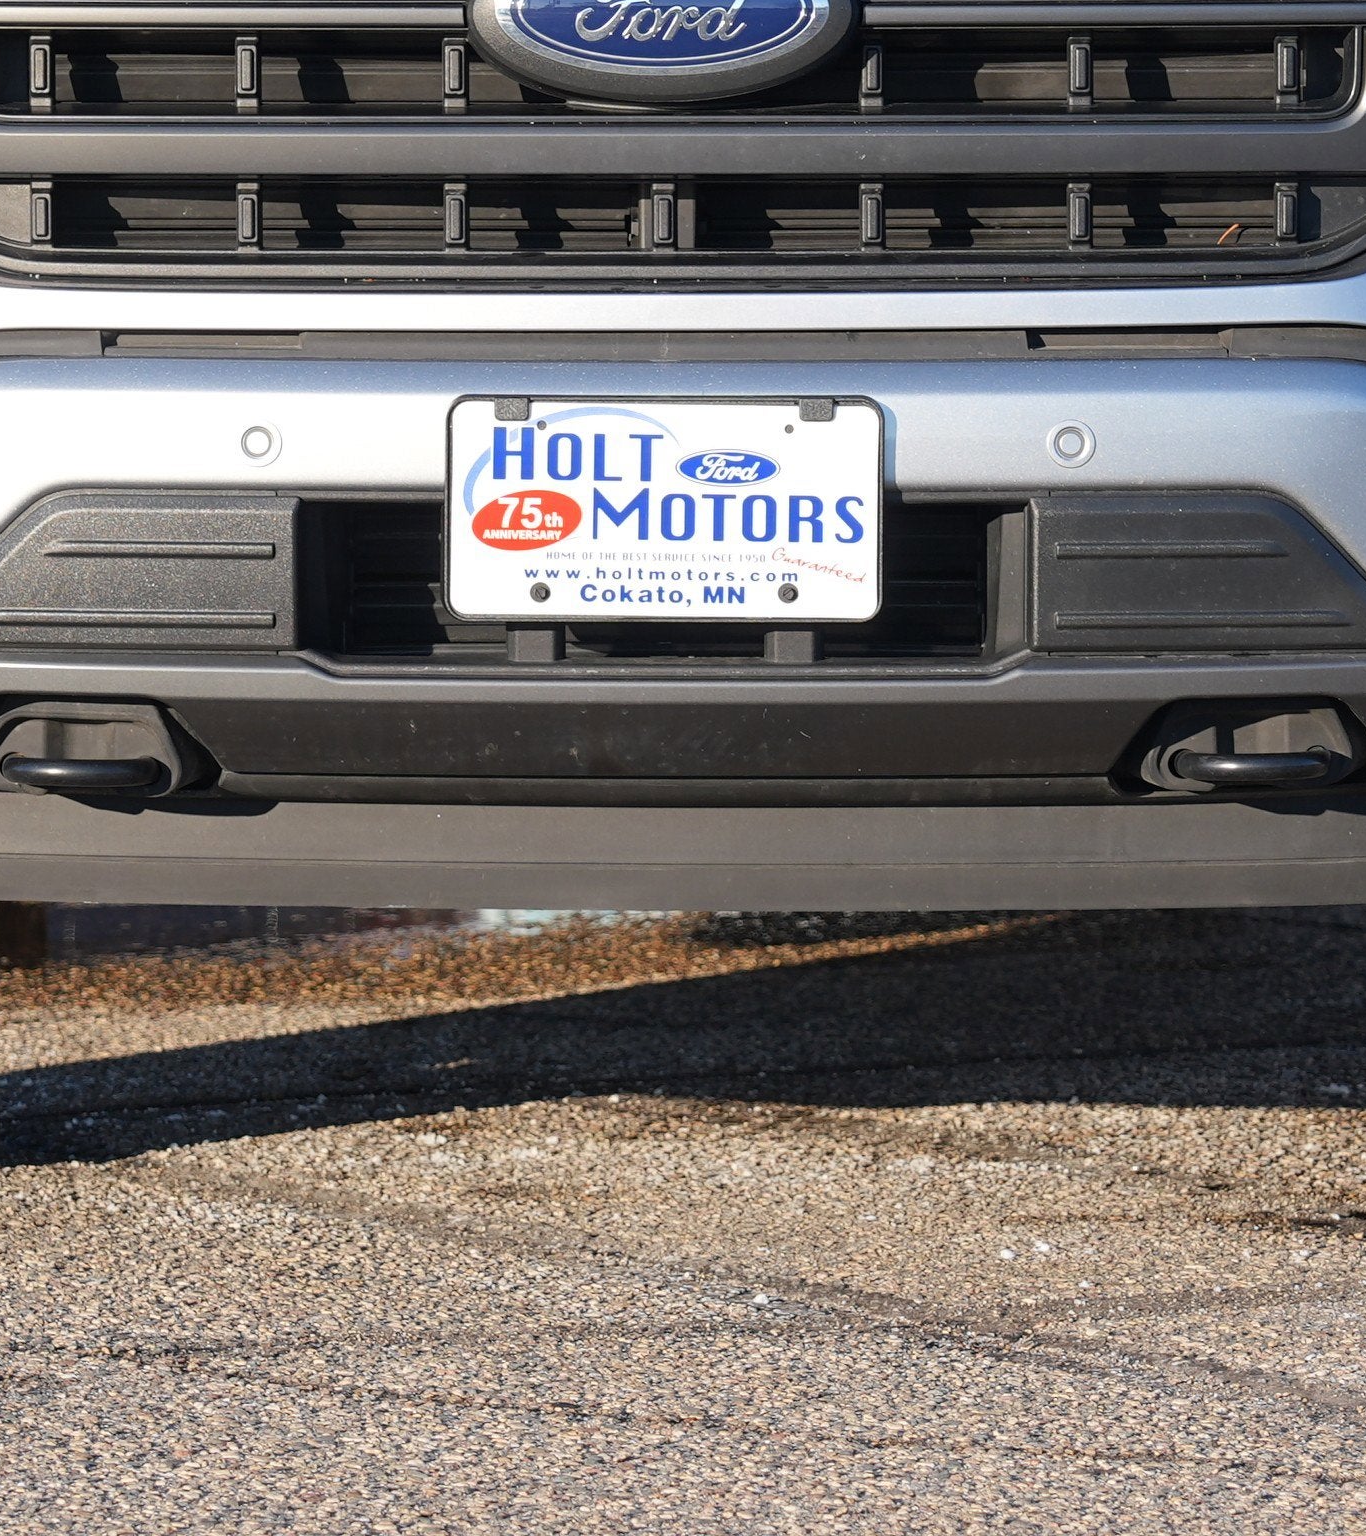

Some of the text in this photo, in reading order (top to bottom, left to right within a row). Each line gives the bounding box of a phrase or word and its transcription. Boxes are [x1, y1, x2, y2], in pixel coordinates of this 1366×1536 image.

[492, 426, 664, 482] HOLT
[694, 452, 760, 483] Ford
[497, 497, 564, 530] 75th
[592, 487, 865, 544] MOTORS
[482, 528, 562, 541] ANNIVERSARY
[546, 551, 767, 563] HOME OF THE BEST SERVICE SINCE 1950
[771, 546, 867, 584] Guaranteed
[524, 566, 799, 583] www.holtmotors.com
[579, 583, 746, 607] Cokato, MN
